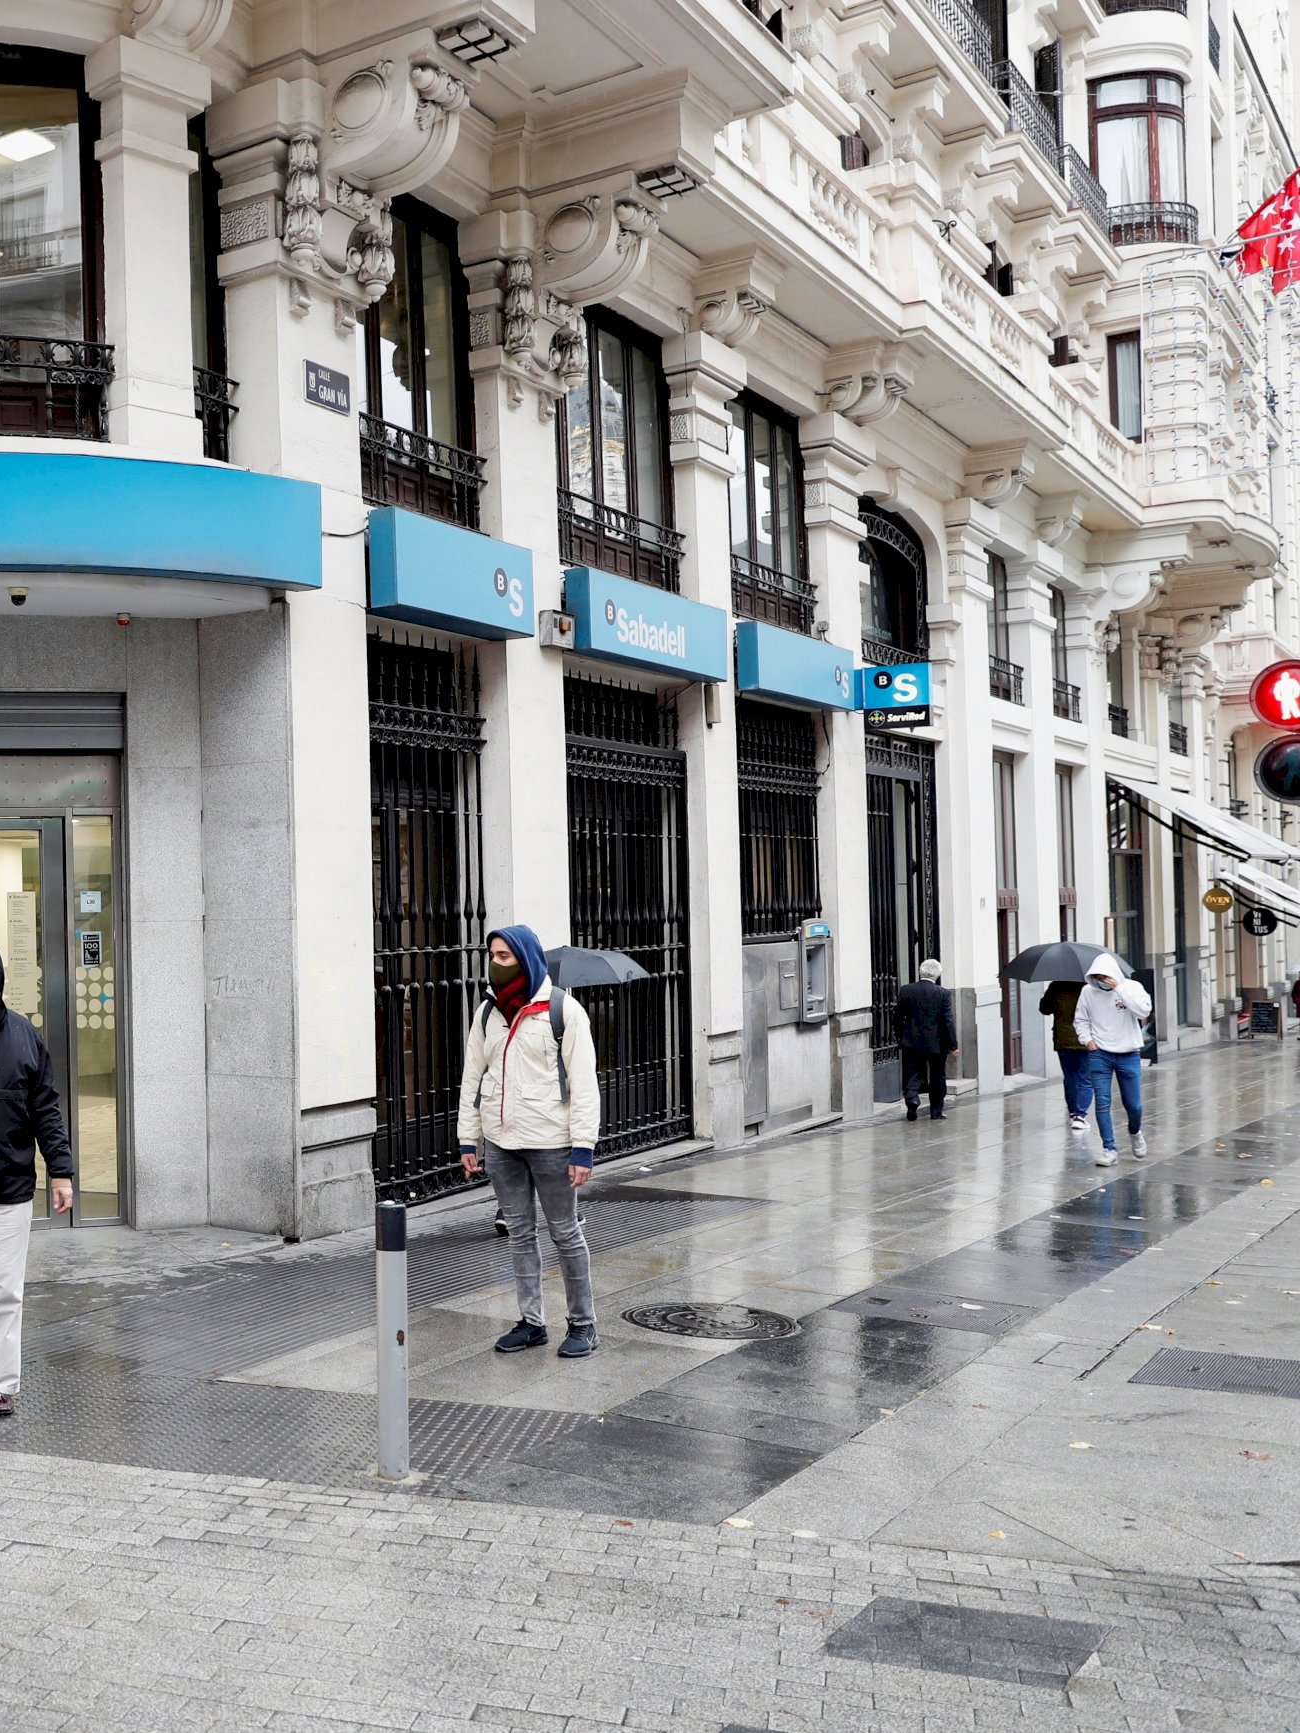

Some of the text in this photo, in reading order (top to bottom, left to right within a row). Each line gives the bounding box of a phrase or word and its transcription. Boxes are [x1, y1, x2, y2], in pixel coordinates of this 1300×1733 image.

[318, 369, 330, 382] CALLE
[319, 385, 348, 408] GRAN VÍA
[509, 578, 524, 617] S
[617, 607, 685, 658] Sabadell
[842, 671, 849, 699] S
[892, 673, 918, 702] S
[887, 711, 925, 722] ServiRed
